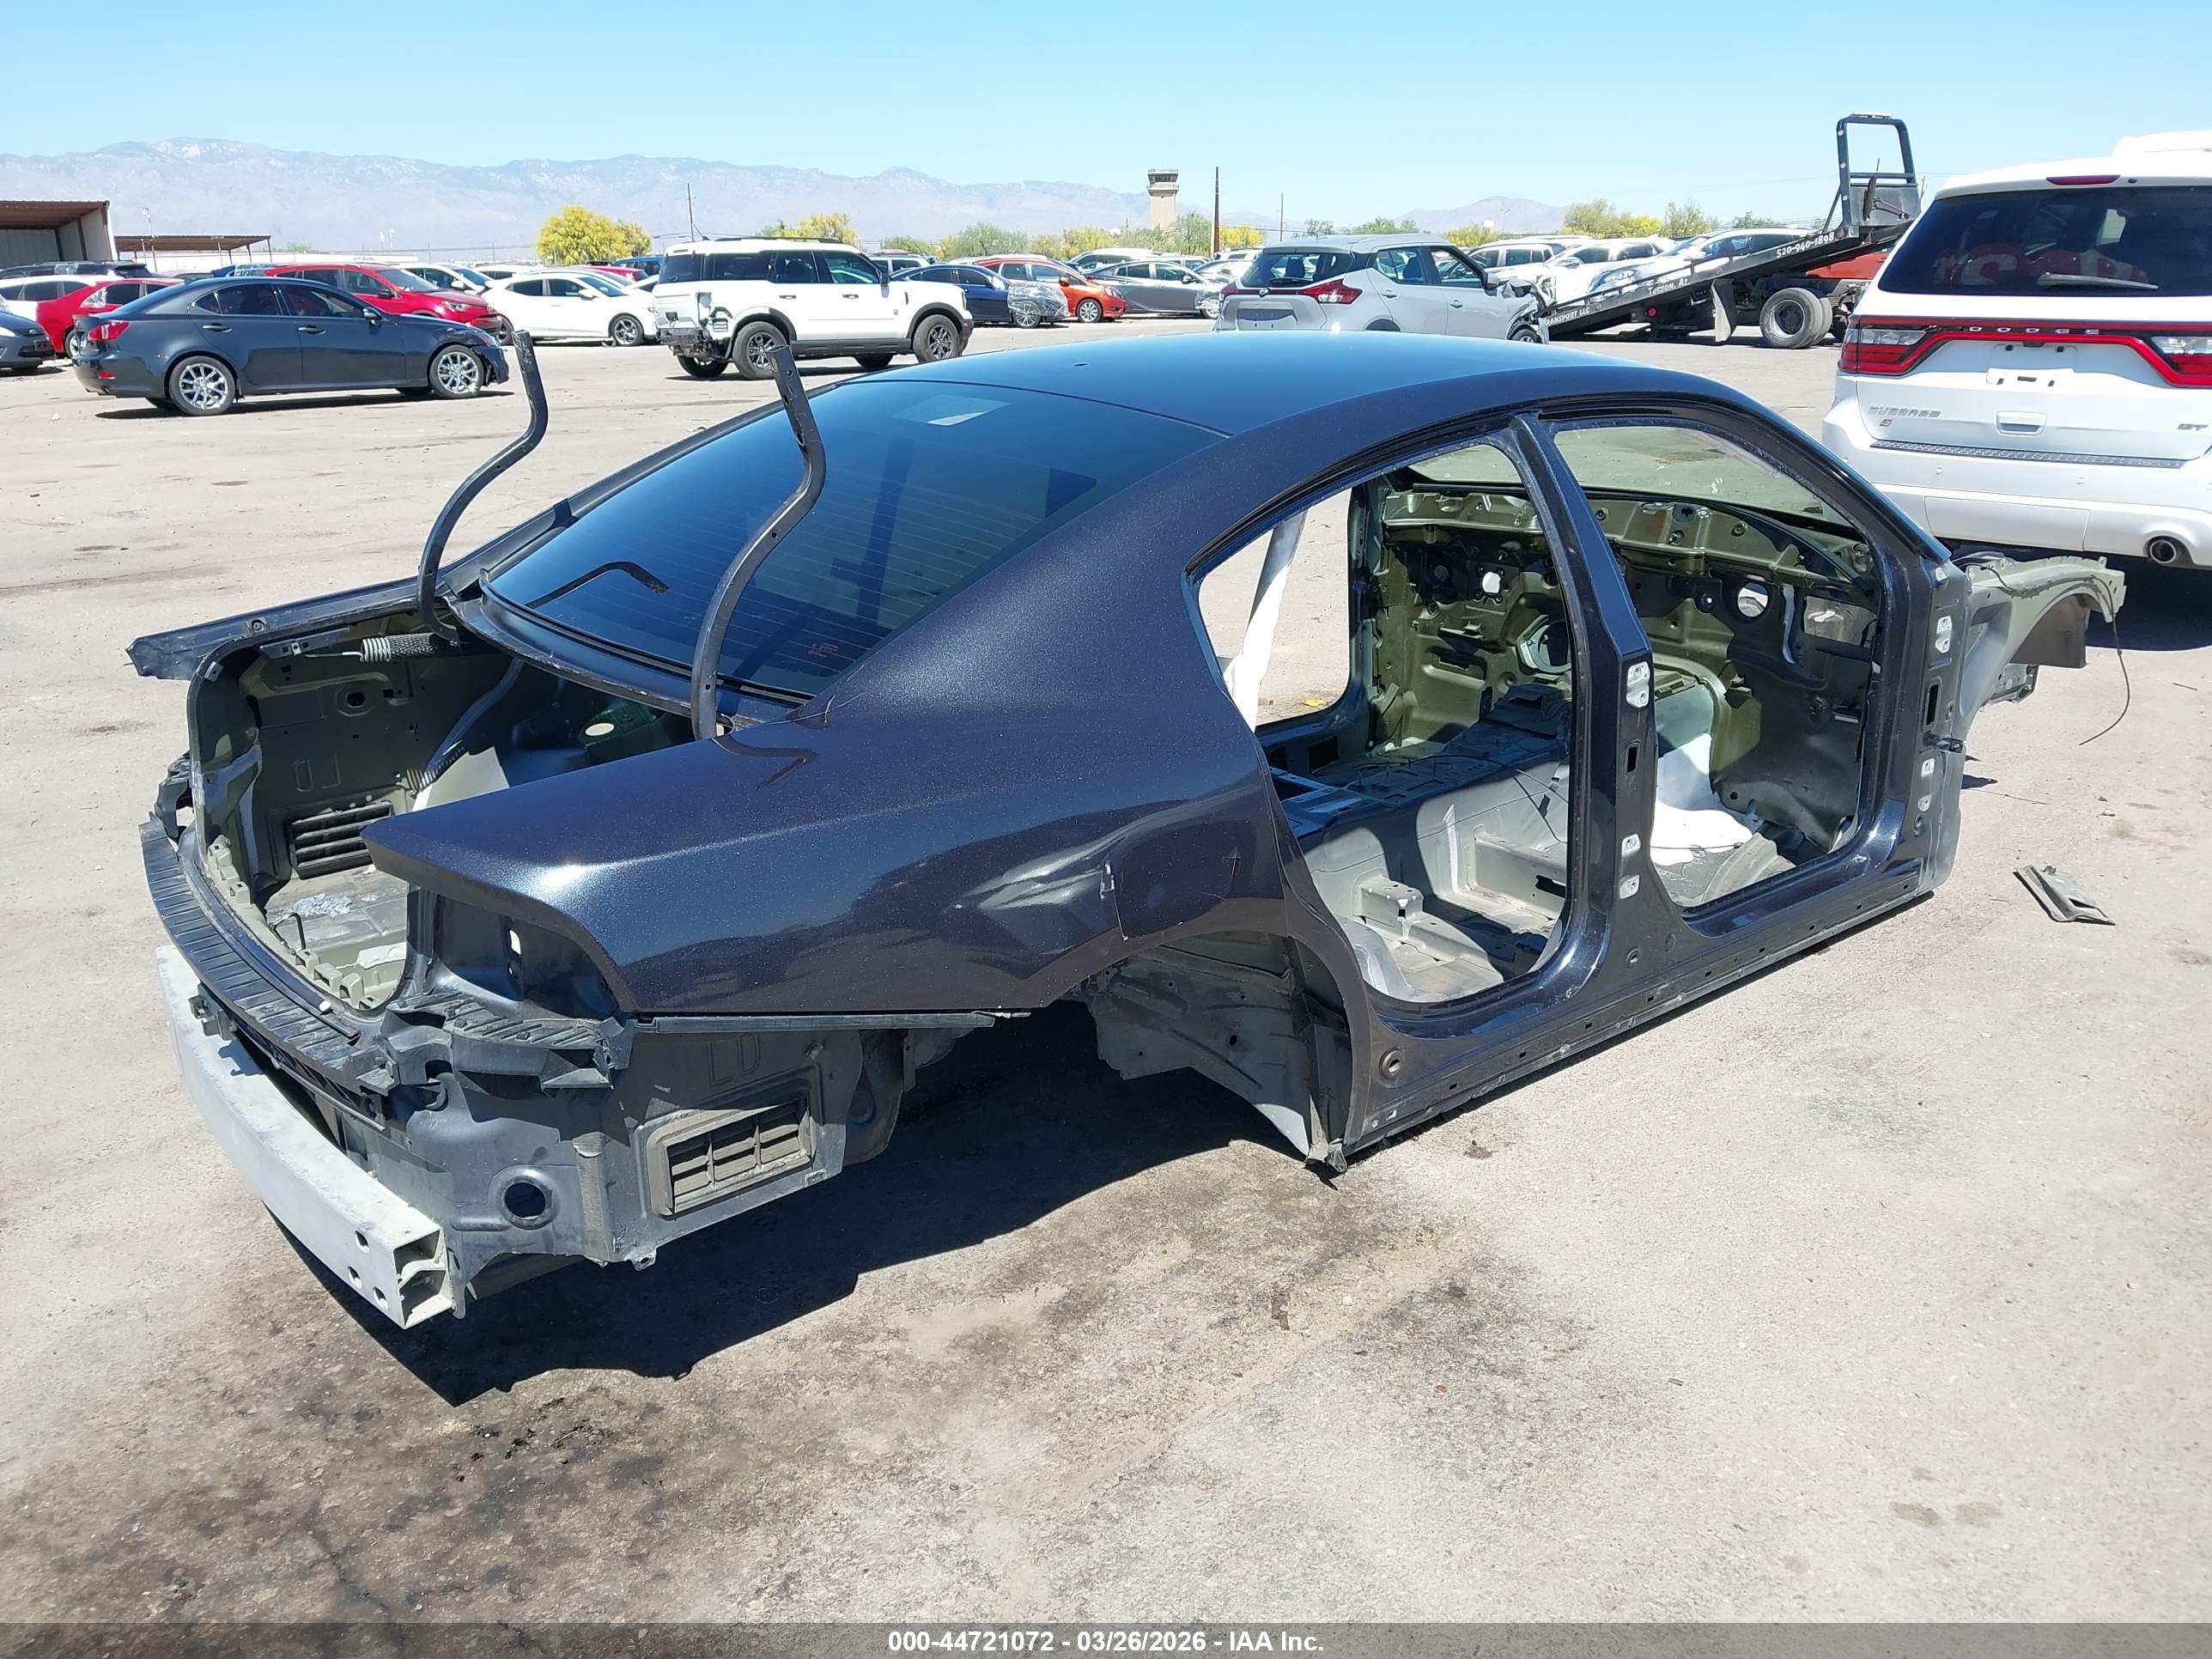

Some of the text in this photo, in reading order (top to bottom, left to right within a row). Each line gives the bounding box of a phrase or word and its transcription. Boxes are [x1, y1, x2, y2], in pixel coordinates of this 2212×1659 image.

[1776, 231, 1835, 258] 520-940-1898
[1546, 307, 1590, 325] RANSPORT LLC
[1968, 325, 2100, 335] DODGE
[2177, 422, 2209, 431] GT
